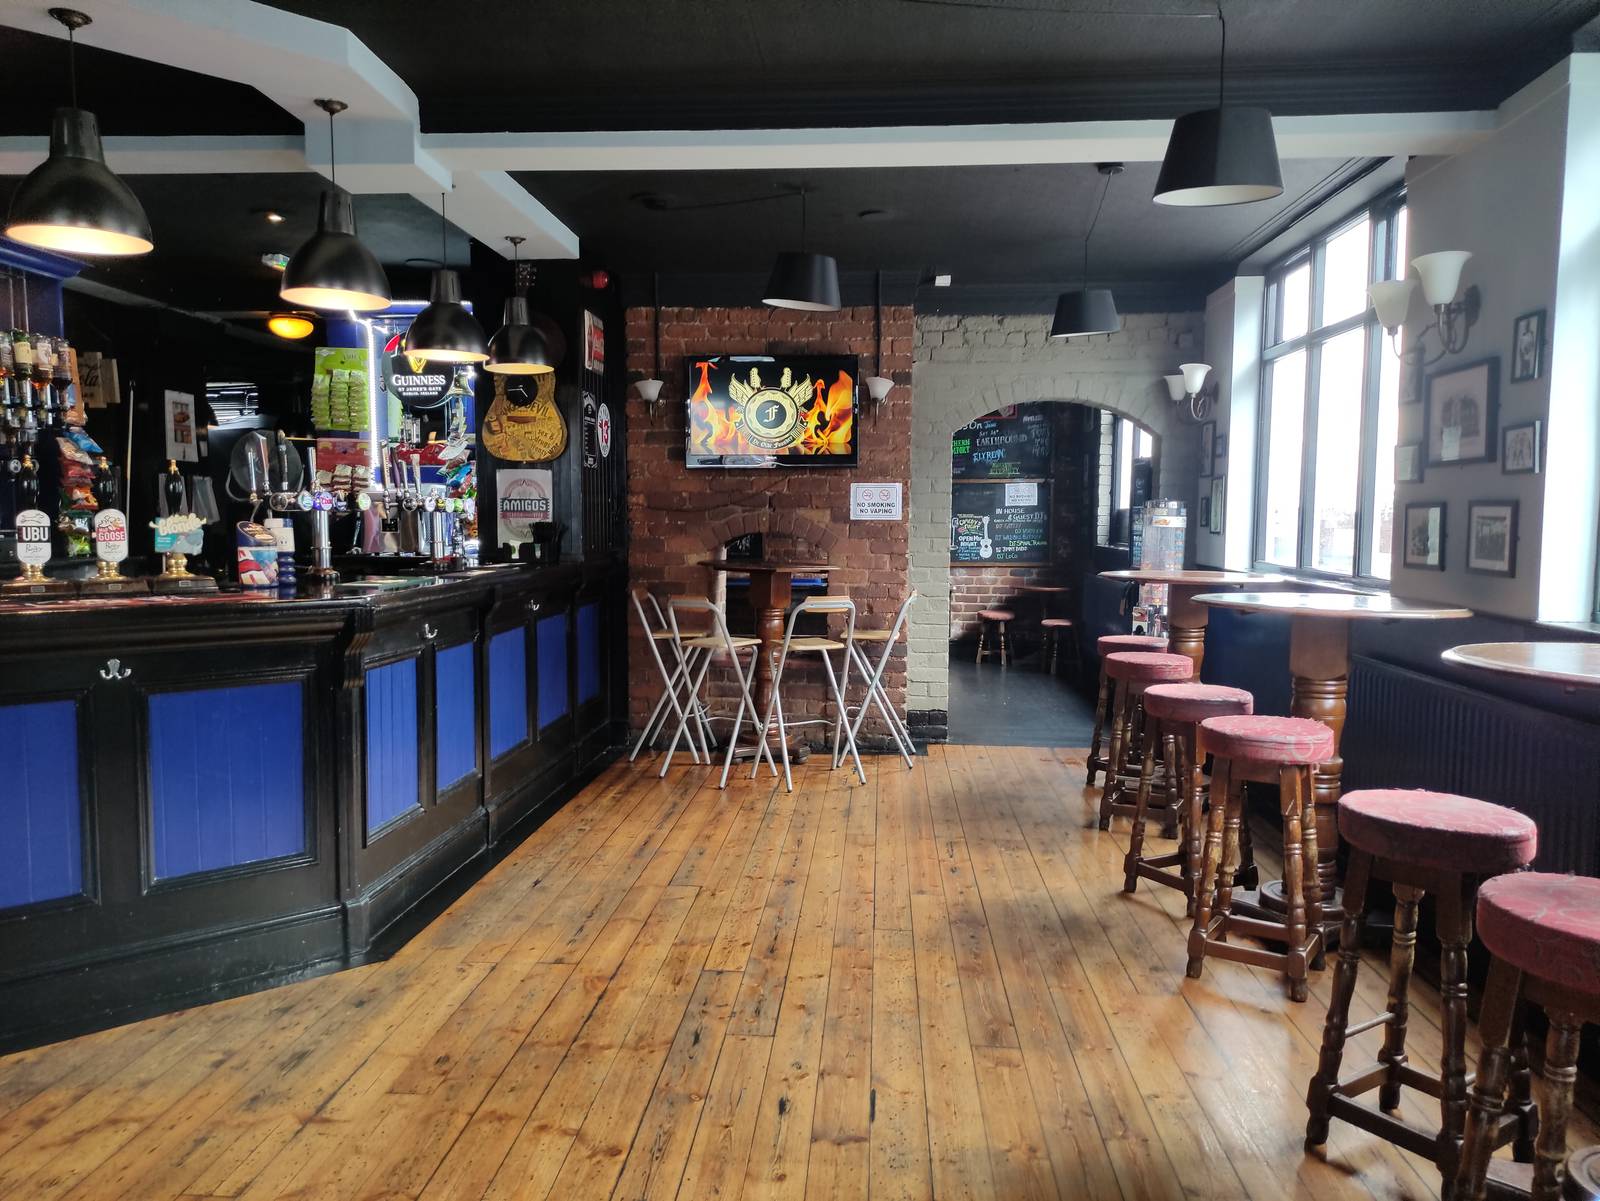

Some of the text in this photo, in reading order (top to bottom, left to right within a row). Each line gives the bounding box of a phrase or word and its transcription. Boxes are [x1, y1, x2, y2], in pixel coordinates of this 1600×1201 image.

[392, 374, 446, 386] GUINNESS
[503, 500, 546, 511] AMIGOS
[22, 526, 49, 541] UBU
[98, 531, 126, 541] GOOSE
